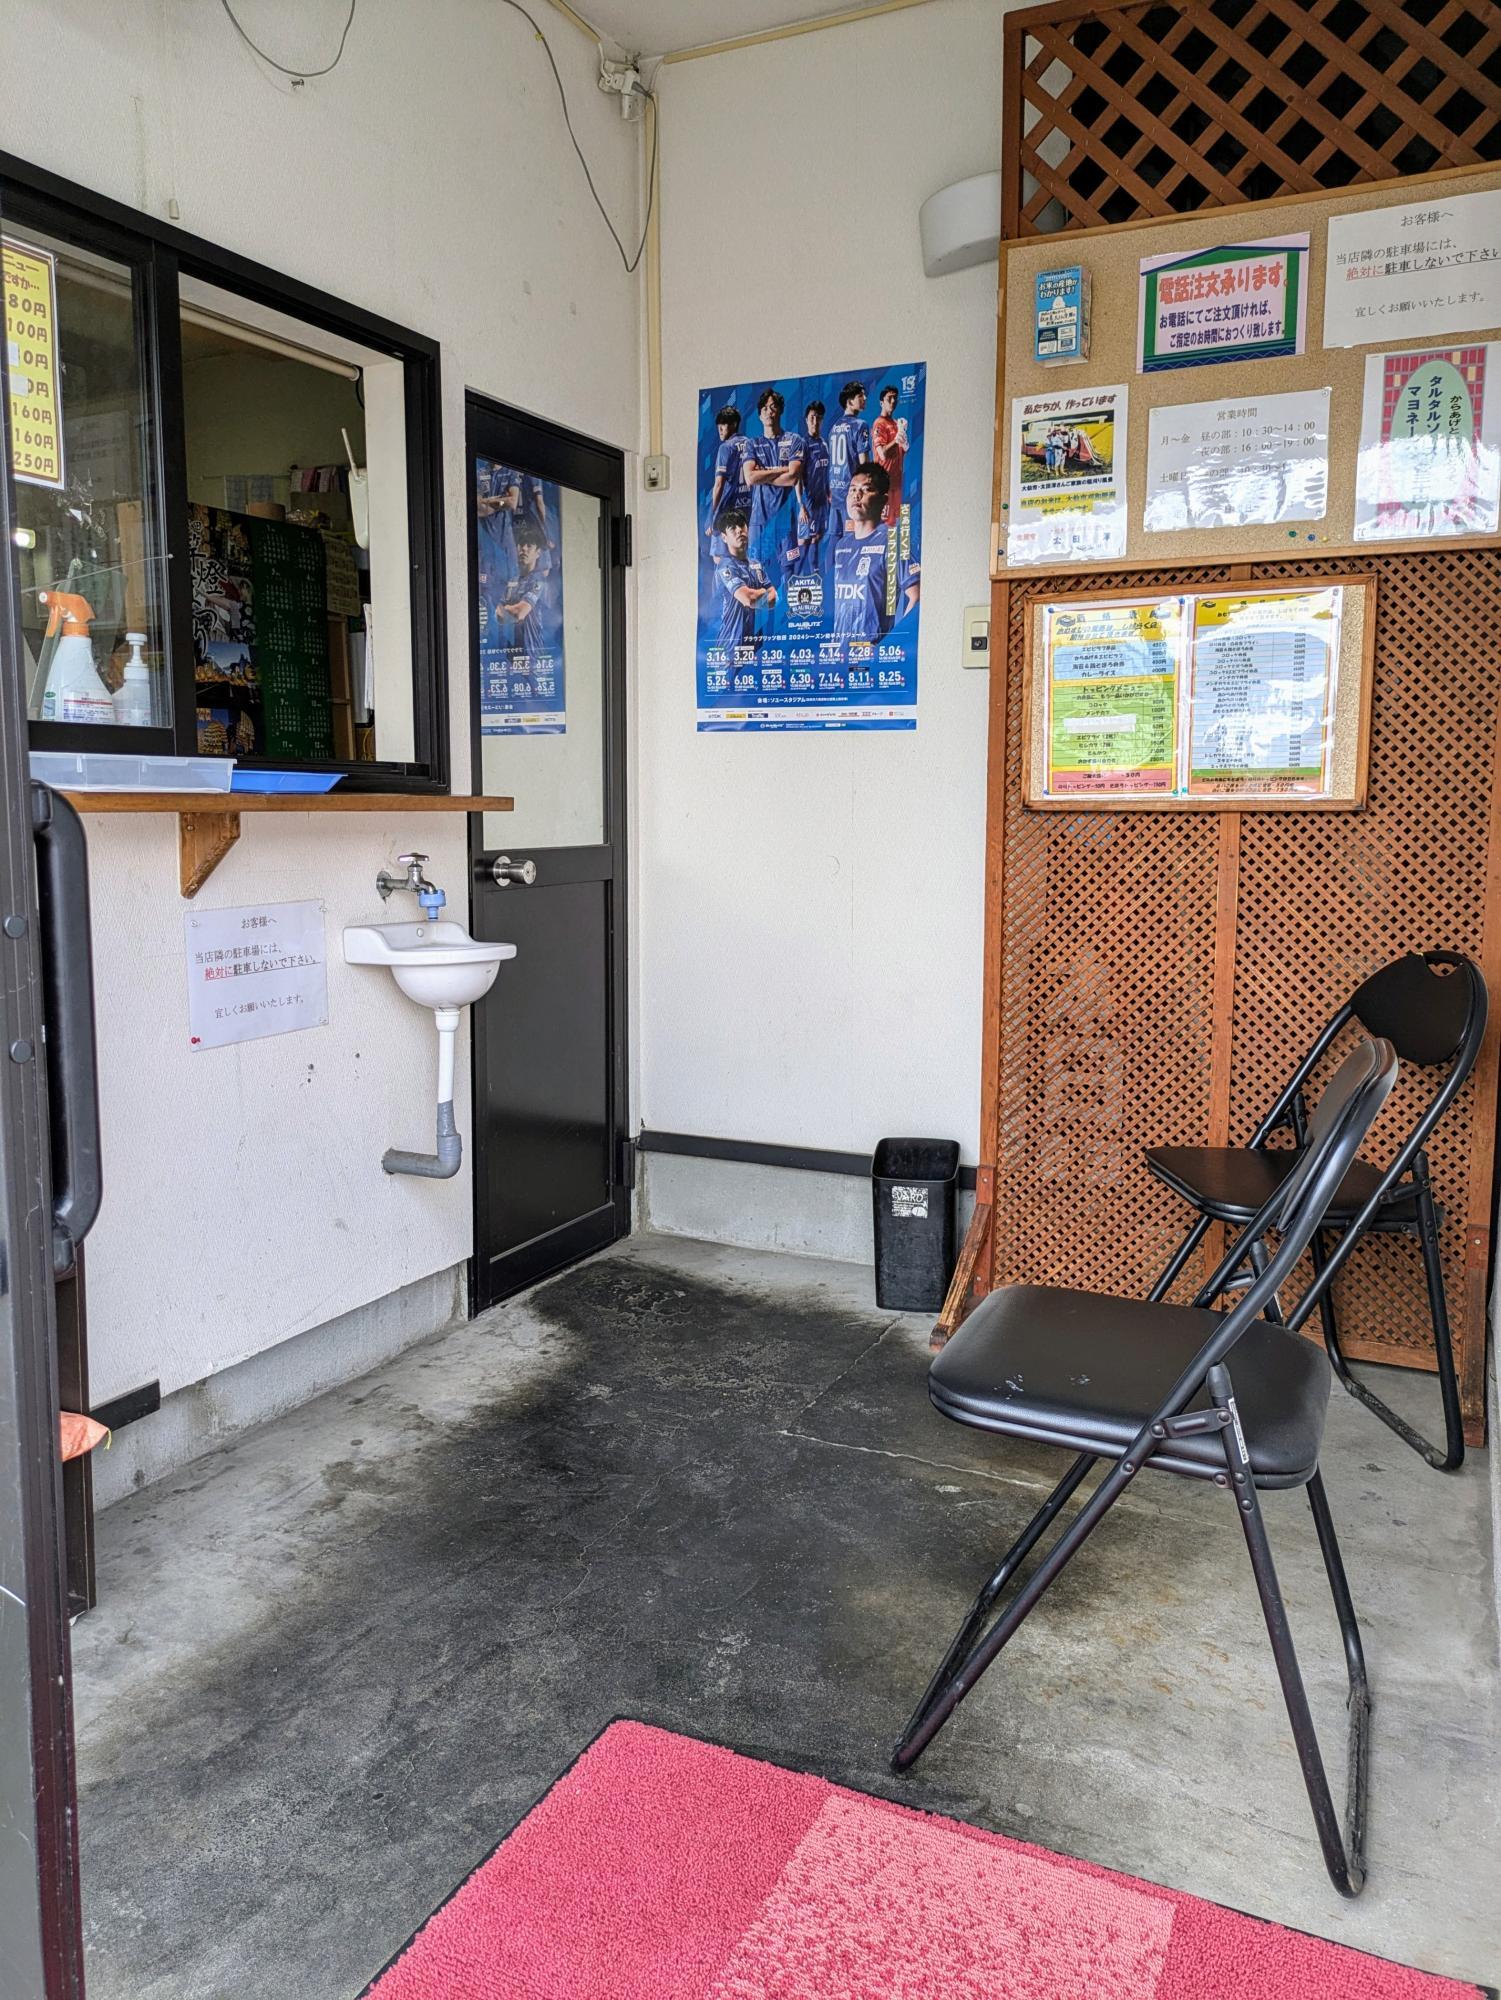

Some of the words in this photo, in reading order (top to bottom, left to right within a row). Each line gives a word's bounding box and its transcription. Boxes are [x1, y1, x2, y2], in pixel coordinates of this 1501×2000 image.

[1400, 210, 1454, 227] お客様へ
[1336, 238, 1457, 266] 当店隣の駐車場には、
[1159, 261, 1288, 305] 電話注文承ります。
[8, 293, 47, 318] 80円
[1159, 300, 1272, 329] お電話にてご注文頂ければ、
[1354, 291, 1486, 318] 宜しくお願いいたします。
[7, 317, 48, 343] 100円
[1170, 320, 1286, 348] ご指定のお時間におつくり致します。
[12, 401, 52, 425] 160円
[1024, 394, 1117, 416] 私たちが、作っています
[1216, 407, 1258, 421] 営業時間
[1405, 386, 1422, 437] マヨネー
[1426, 375, 1443, 434] タルタルソ
[15, 427, 54, 450] 160円
[831, 434, 847, 466] 10
[14, 452, 54, 474] 250円
[901, 504, 910, 560] さあ行くぞ
[795, 578, 816, 586] AKITA
[837, 584, 865, 600] TDK
[707, 652, 726, 662] 3.16
[734, 651, 754, 660] 3.20
[762, 650, 782, 660] 3.30
[790, 649, 811, 659] 4.03
[819, 648, 840, 658] 4.14
[849, 647, 870, 657] 4.28
[879, 646, 900, 656] 5.06
[707, 676, 727, 686] 5.26
[734, 675, 754, 685] 6.08
[762, 675, 782, 685] 6.23
[790, 674, 811, 684] 6.30
[819, 673, 840, 683] 7.14
[849, 672, 870, 682] 8.11
[879, 671, 901, 681] 8.25
[241, 915, 277, 929] お客様へ
[195, 942, 283, 964] 当店隣の駐車場には、
[204, 954, 318, 980] 絶対に駐車しないで下さい。
[214, 994, 304, 1019] 宜しくお願いいたします。
